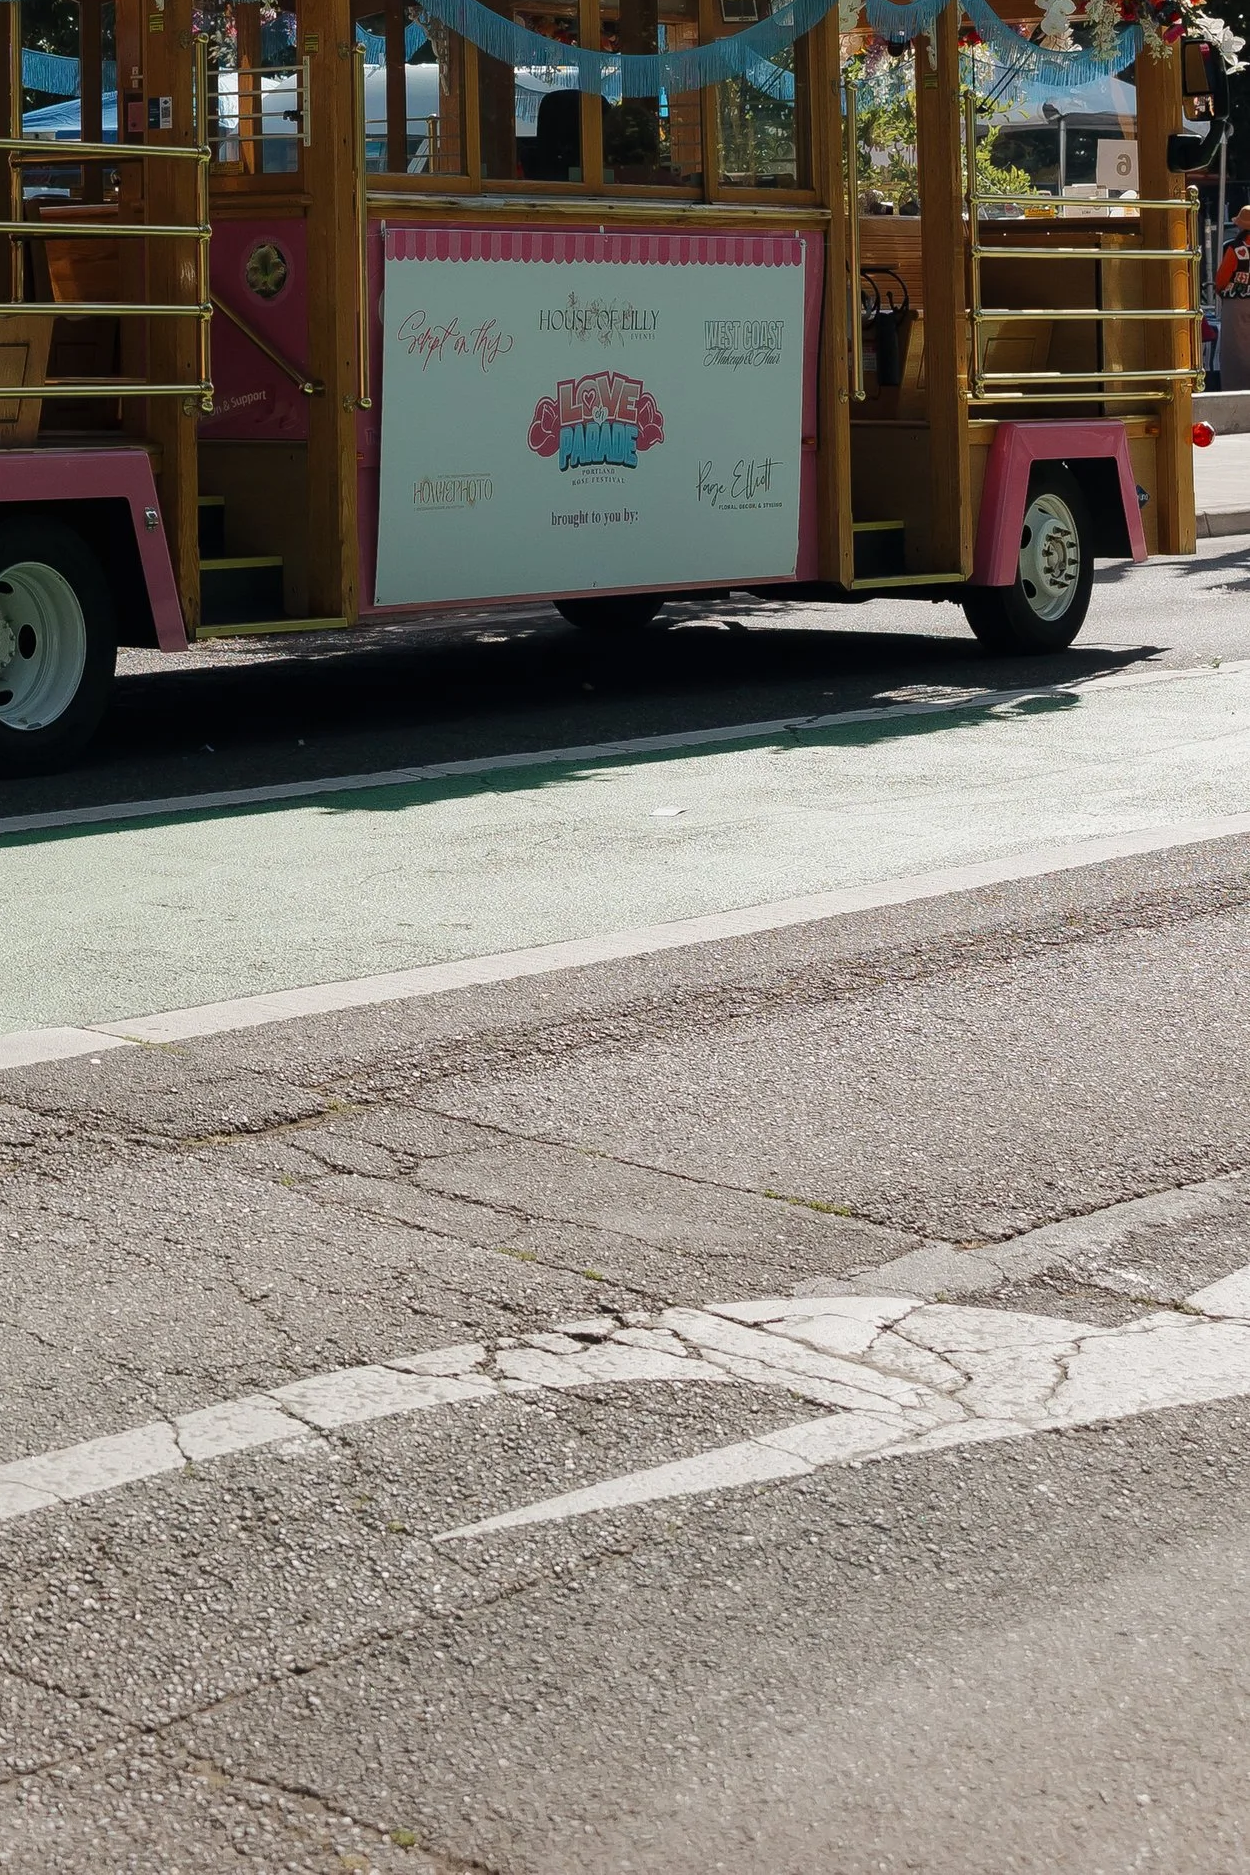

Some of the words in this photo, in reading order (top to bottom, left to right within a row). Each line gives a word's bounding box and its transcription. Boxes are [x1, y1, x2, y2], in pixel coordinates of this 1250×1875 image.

[539, 309, 592, 331] HOUSE
[596, 309, 619, 331] OF
[622, 309, 660, 331] LILLY
[704, 320, 741, 351] WEST
[742, 320, 785, 351] COAST
[222, 400, 230, 412] &
[230, 390, 266, 408] Support
[558, 372, 642, 426] LOVE
[558, 421, 639, 472] PARADE
[581, 468, 616, 476] PORTLAND
[591, 476, 626, 484] FESTIVAL
[551, 510, 589, 528] brought
[591, 511, 601, 524] to
[603, 512, 621, 526] you
[623, 507, 639, 525] by:
